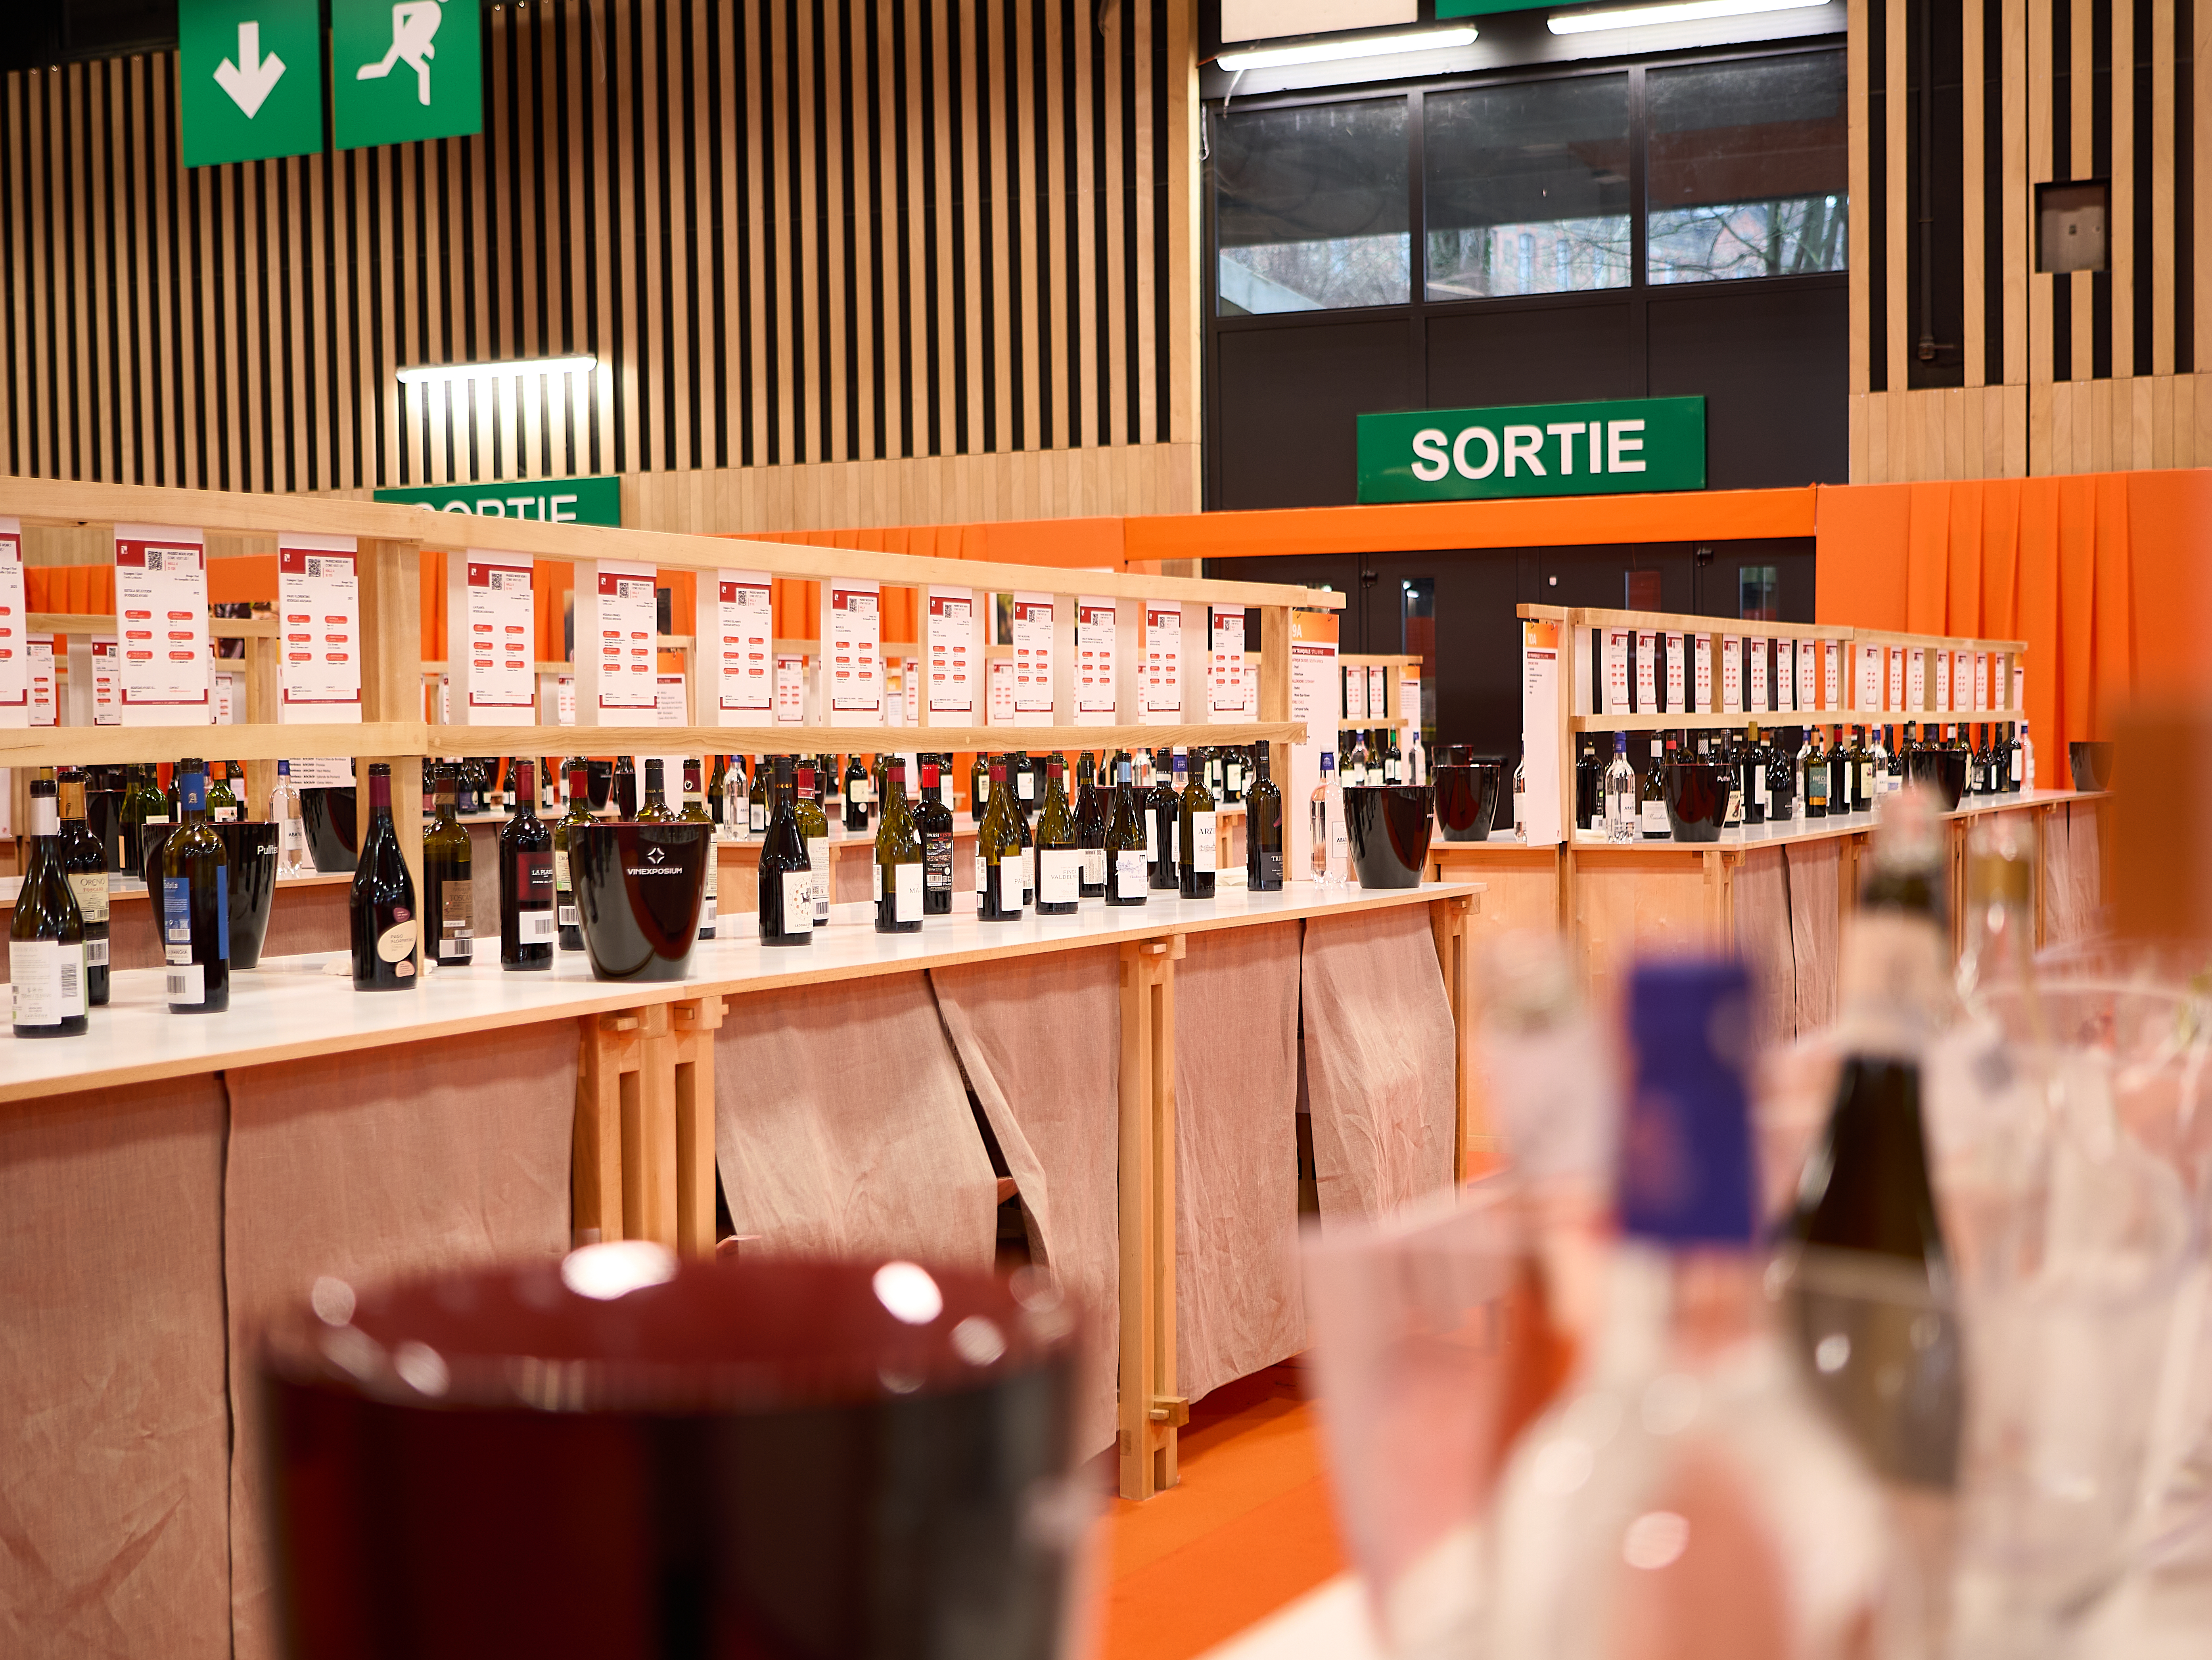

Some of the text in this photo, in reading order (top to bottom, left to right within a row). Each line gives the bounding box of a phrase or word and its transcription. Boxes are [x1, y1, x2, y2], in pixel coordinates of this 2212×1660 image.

[1411, 419, 1646, 482] SORTIE
[414, 494, 578, 523] TIE
[1292, 624, 1302, 638] 9A
[1528, 634, 1537, 645] 10A
[257, 845, 278, 855] Pullte
